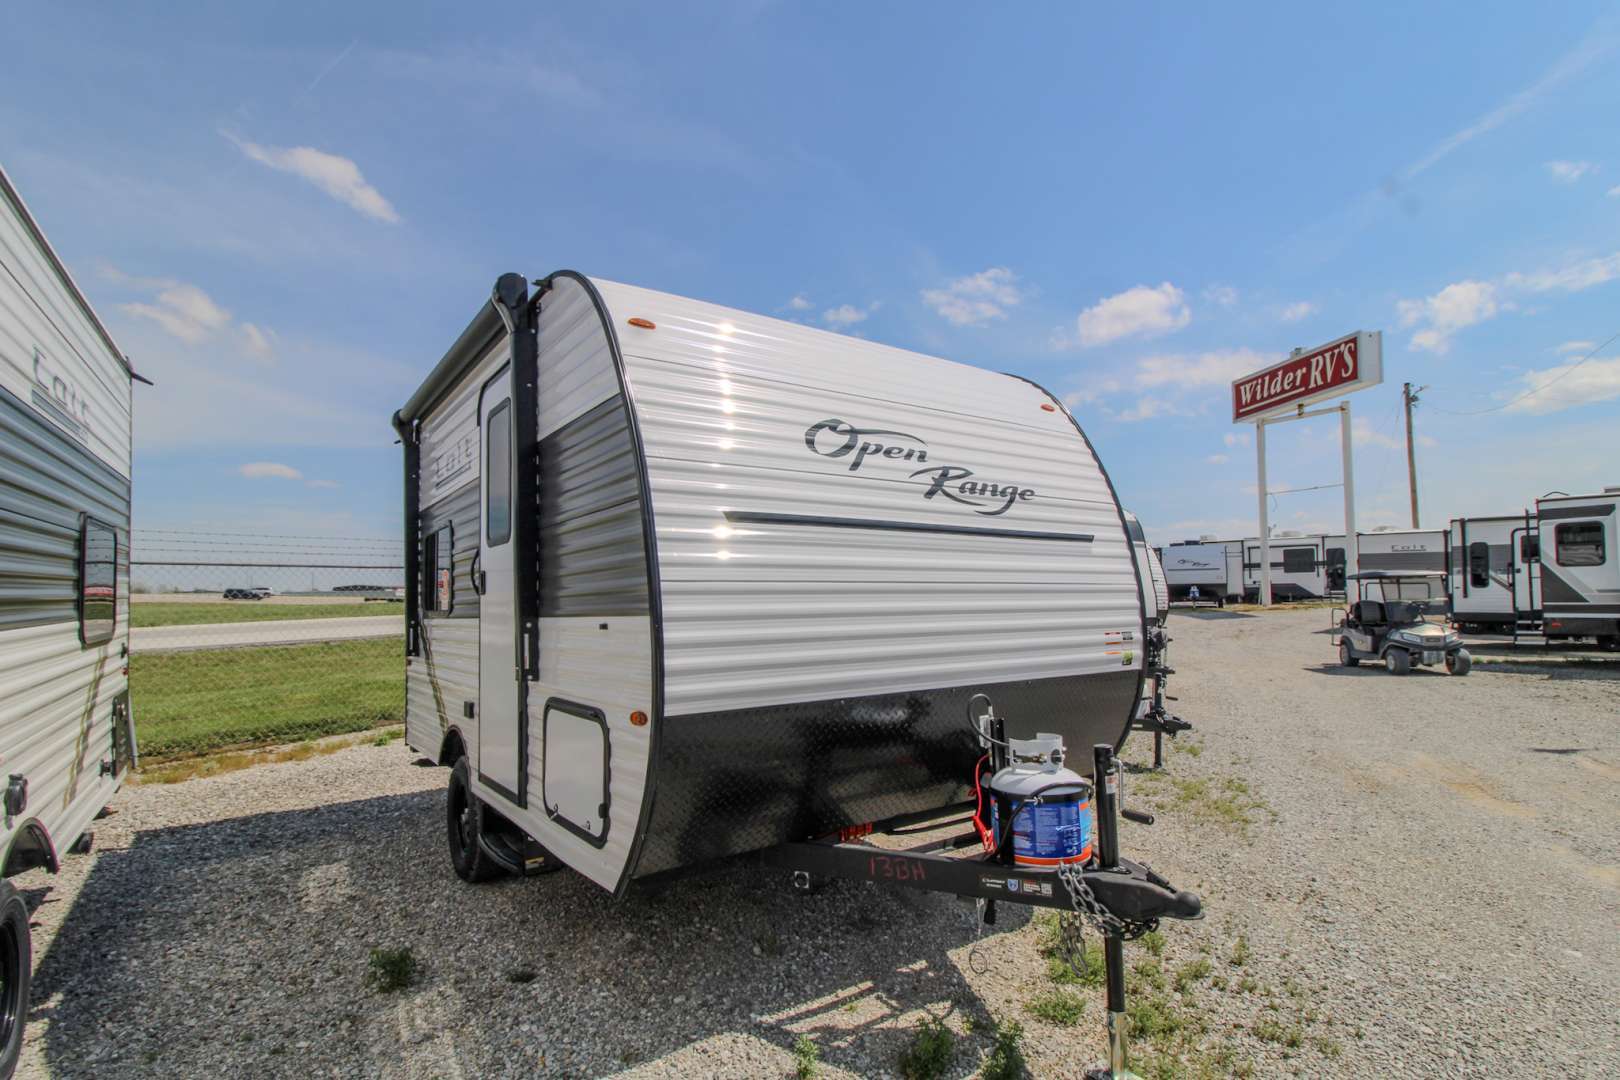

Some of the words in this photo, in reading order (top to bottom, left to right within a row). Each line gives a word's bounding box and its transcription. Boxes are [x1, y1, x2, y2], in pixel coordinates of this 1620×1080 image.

[1239, 366, 1307, 405] Wilder
[1309, 342, 1355, 389] RV'S
[805, 418, 928, 471] Open
[908, 466, 1035, 515] Range
[868, 856, 927, 880] 13BH
